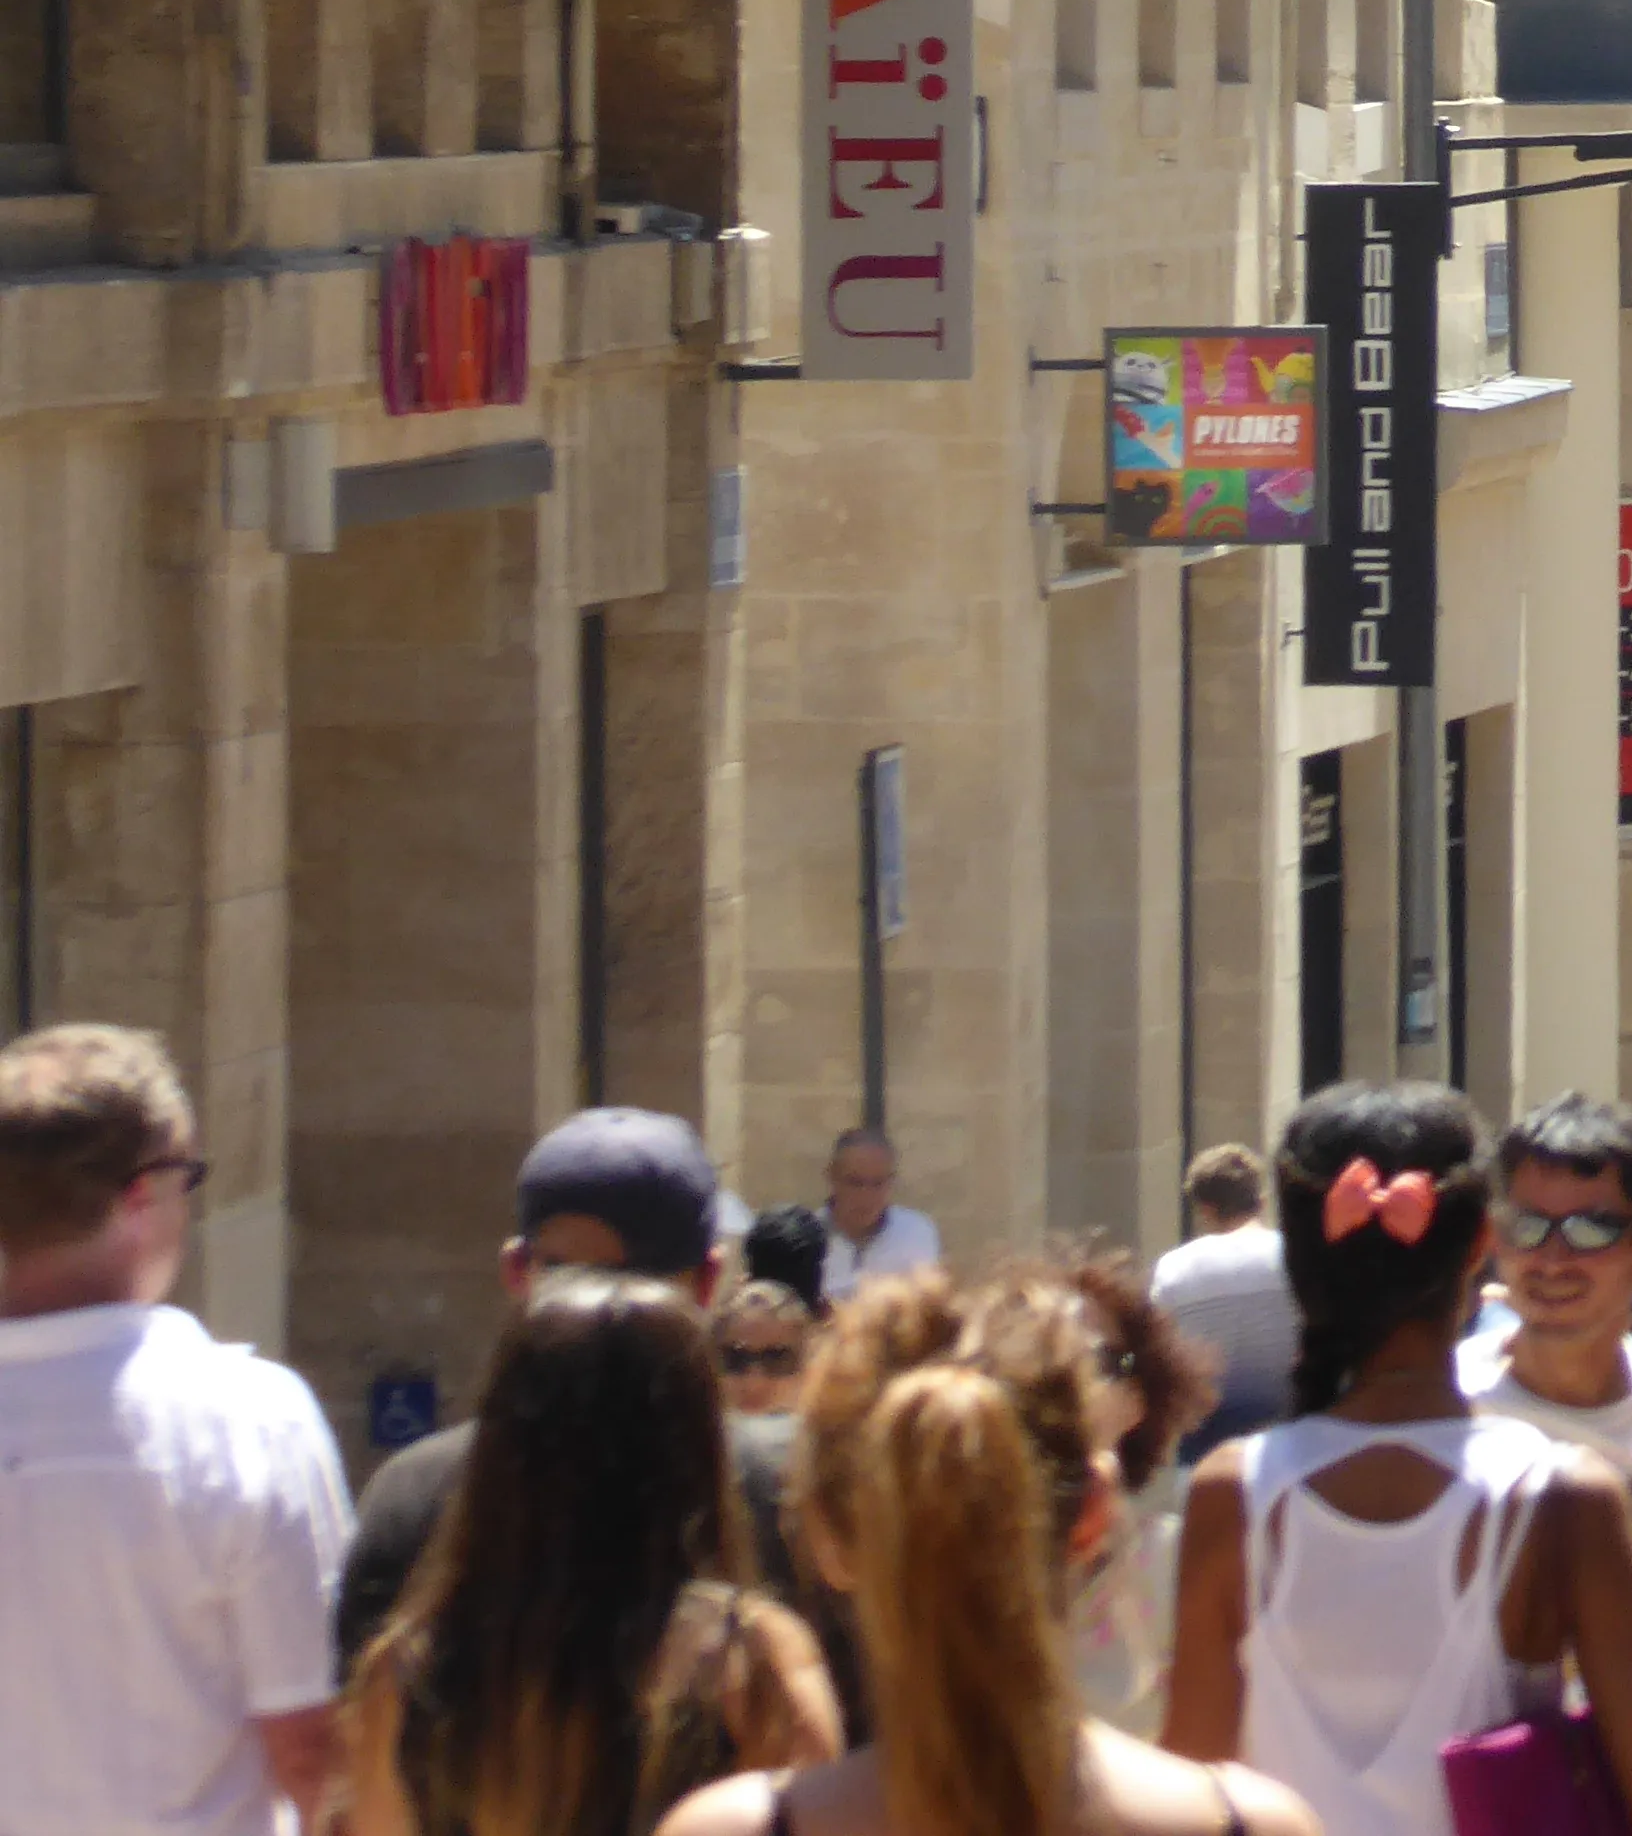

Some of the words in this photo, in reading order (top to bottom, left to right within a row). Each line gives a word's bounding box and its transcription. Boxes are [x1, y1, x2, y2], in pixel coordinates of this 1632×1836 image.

[1353, 196, 1393, 392] Bear
[1359, 406, 1392, 533] and
[1351, 548, 1391, 672] Pull
